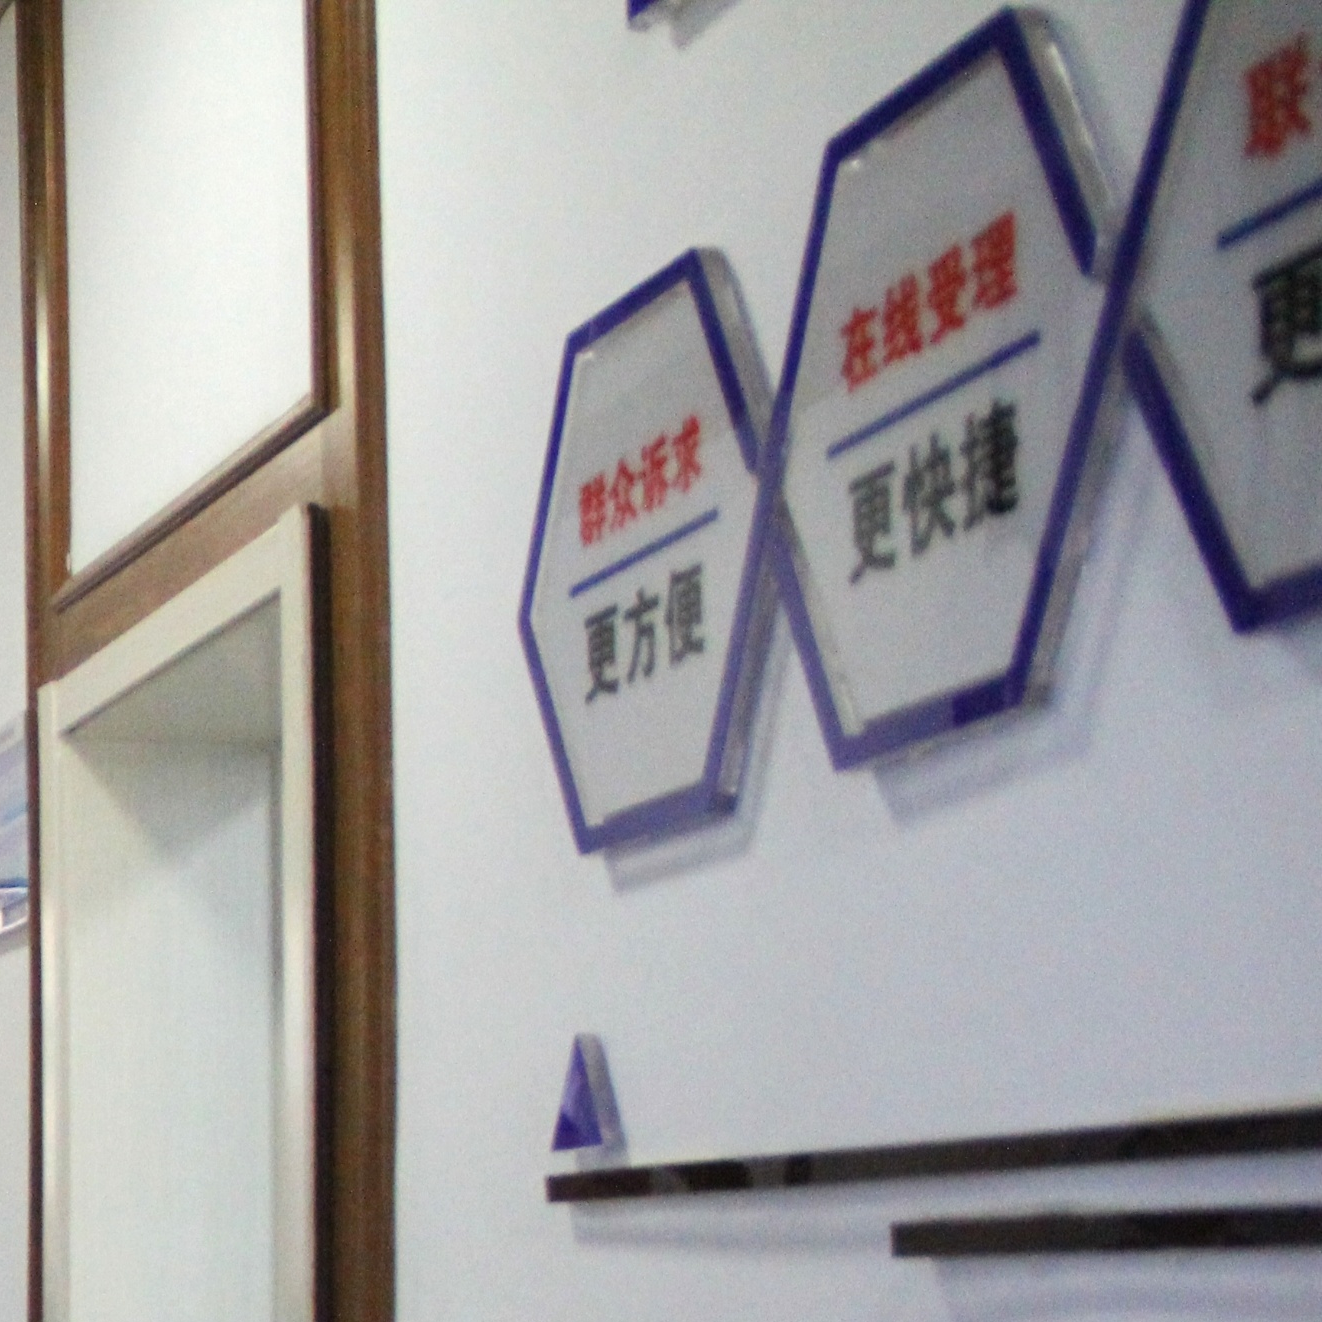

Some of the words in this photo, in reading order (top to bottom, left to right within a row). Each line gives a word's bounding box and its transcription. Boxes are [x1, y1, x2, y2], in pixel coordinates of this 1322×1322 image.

[838, 208, 1020, 393] 在线受理
[577, 414, 704, 547] 群众诉求
[847, 398, 1021, 586] 更快捷
[584, 562, 707, 704] 更方便
